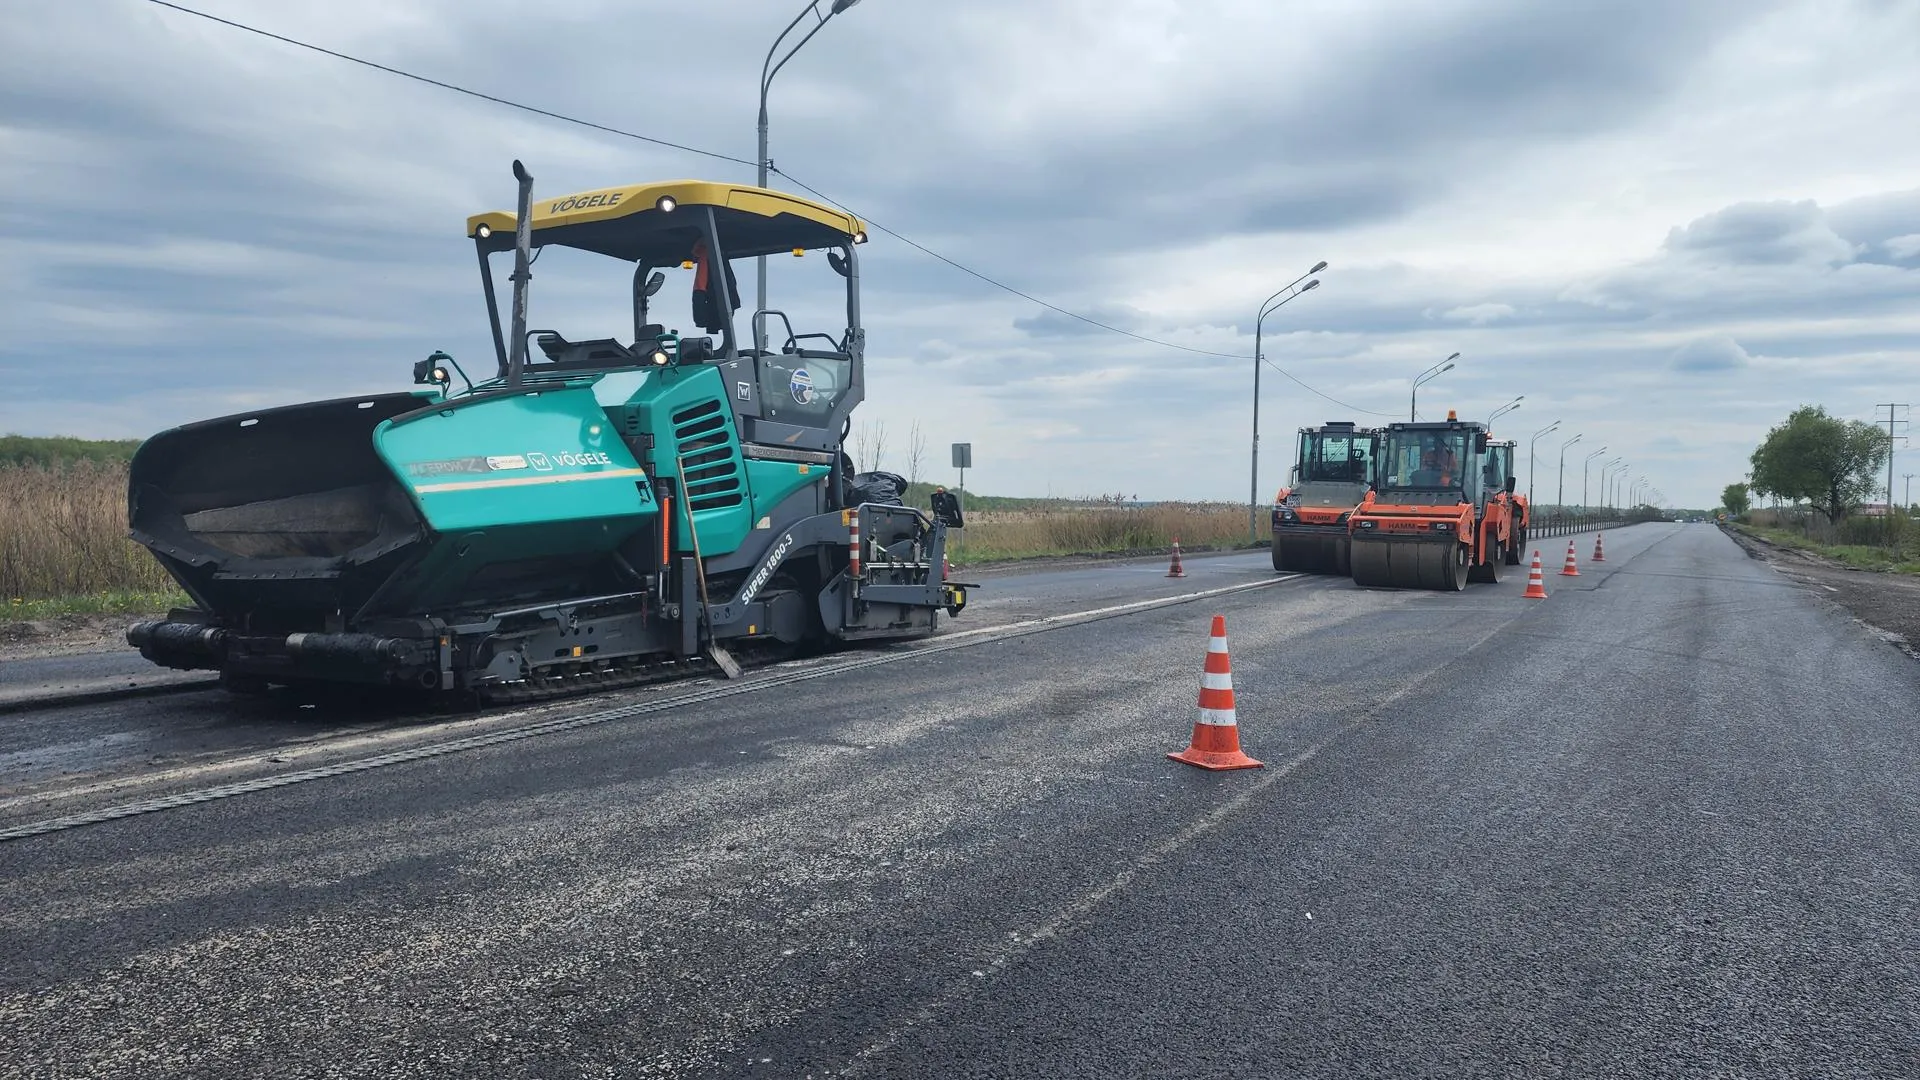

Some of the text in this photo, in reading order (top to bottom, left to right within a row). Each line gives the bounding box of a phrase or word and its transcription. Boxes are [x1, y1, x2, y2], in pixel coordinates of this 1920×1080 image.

[551, 192, 623, 213] VÖGELE
[552, 451, 612, 466] VÖGELE
[741, 533, 793, 605] SUPER 1800-3
